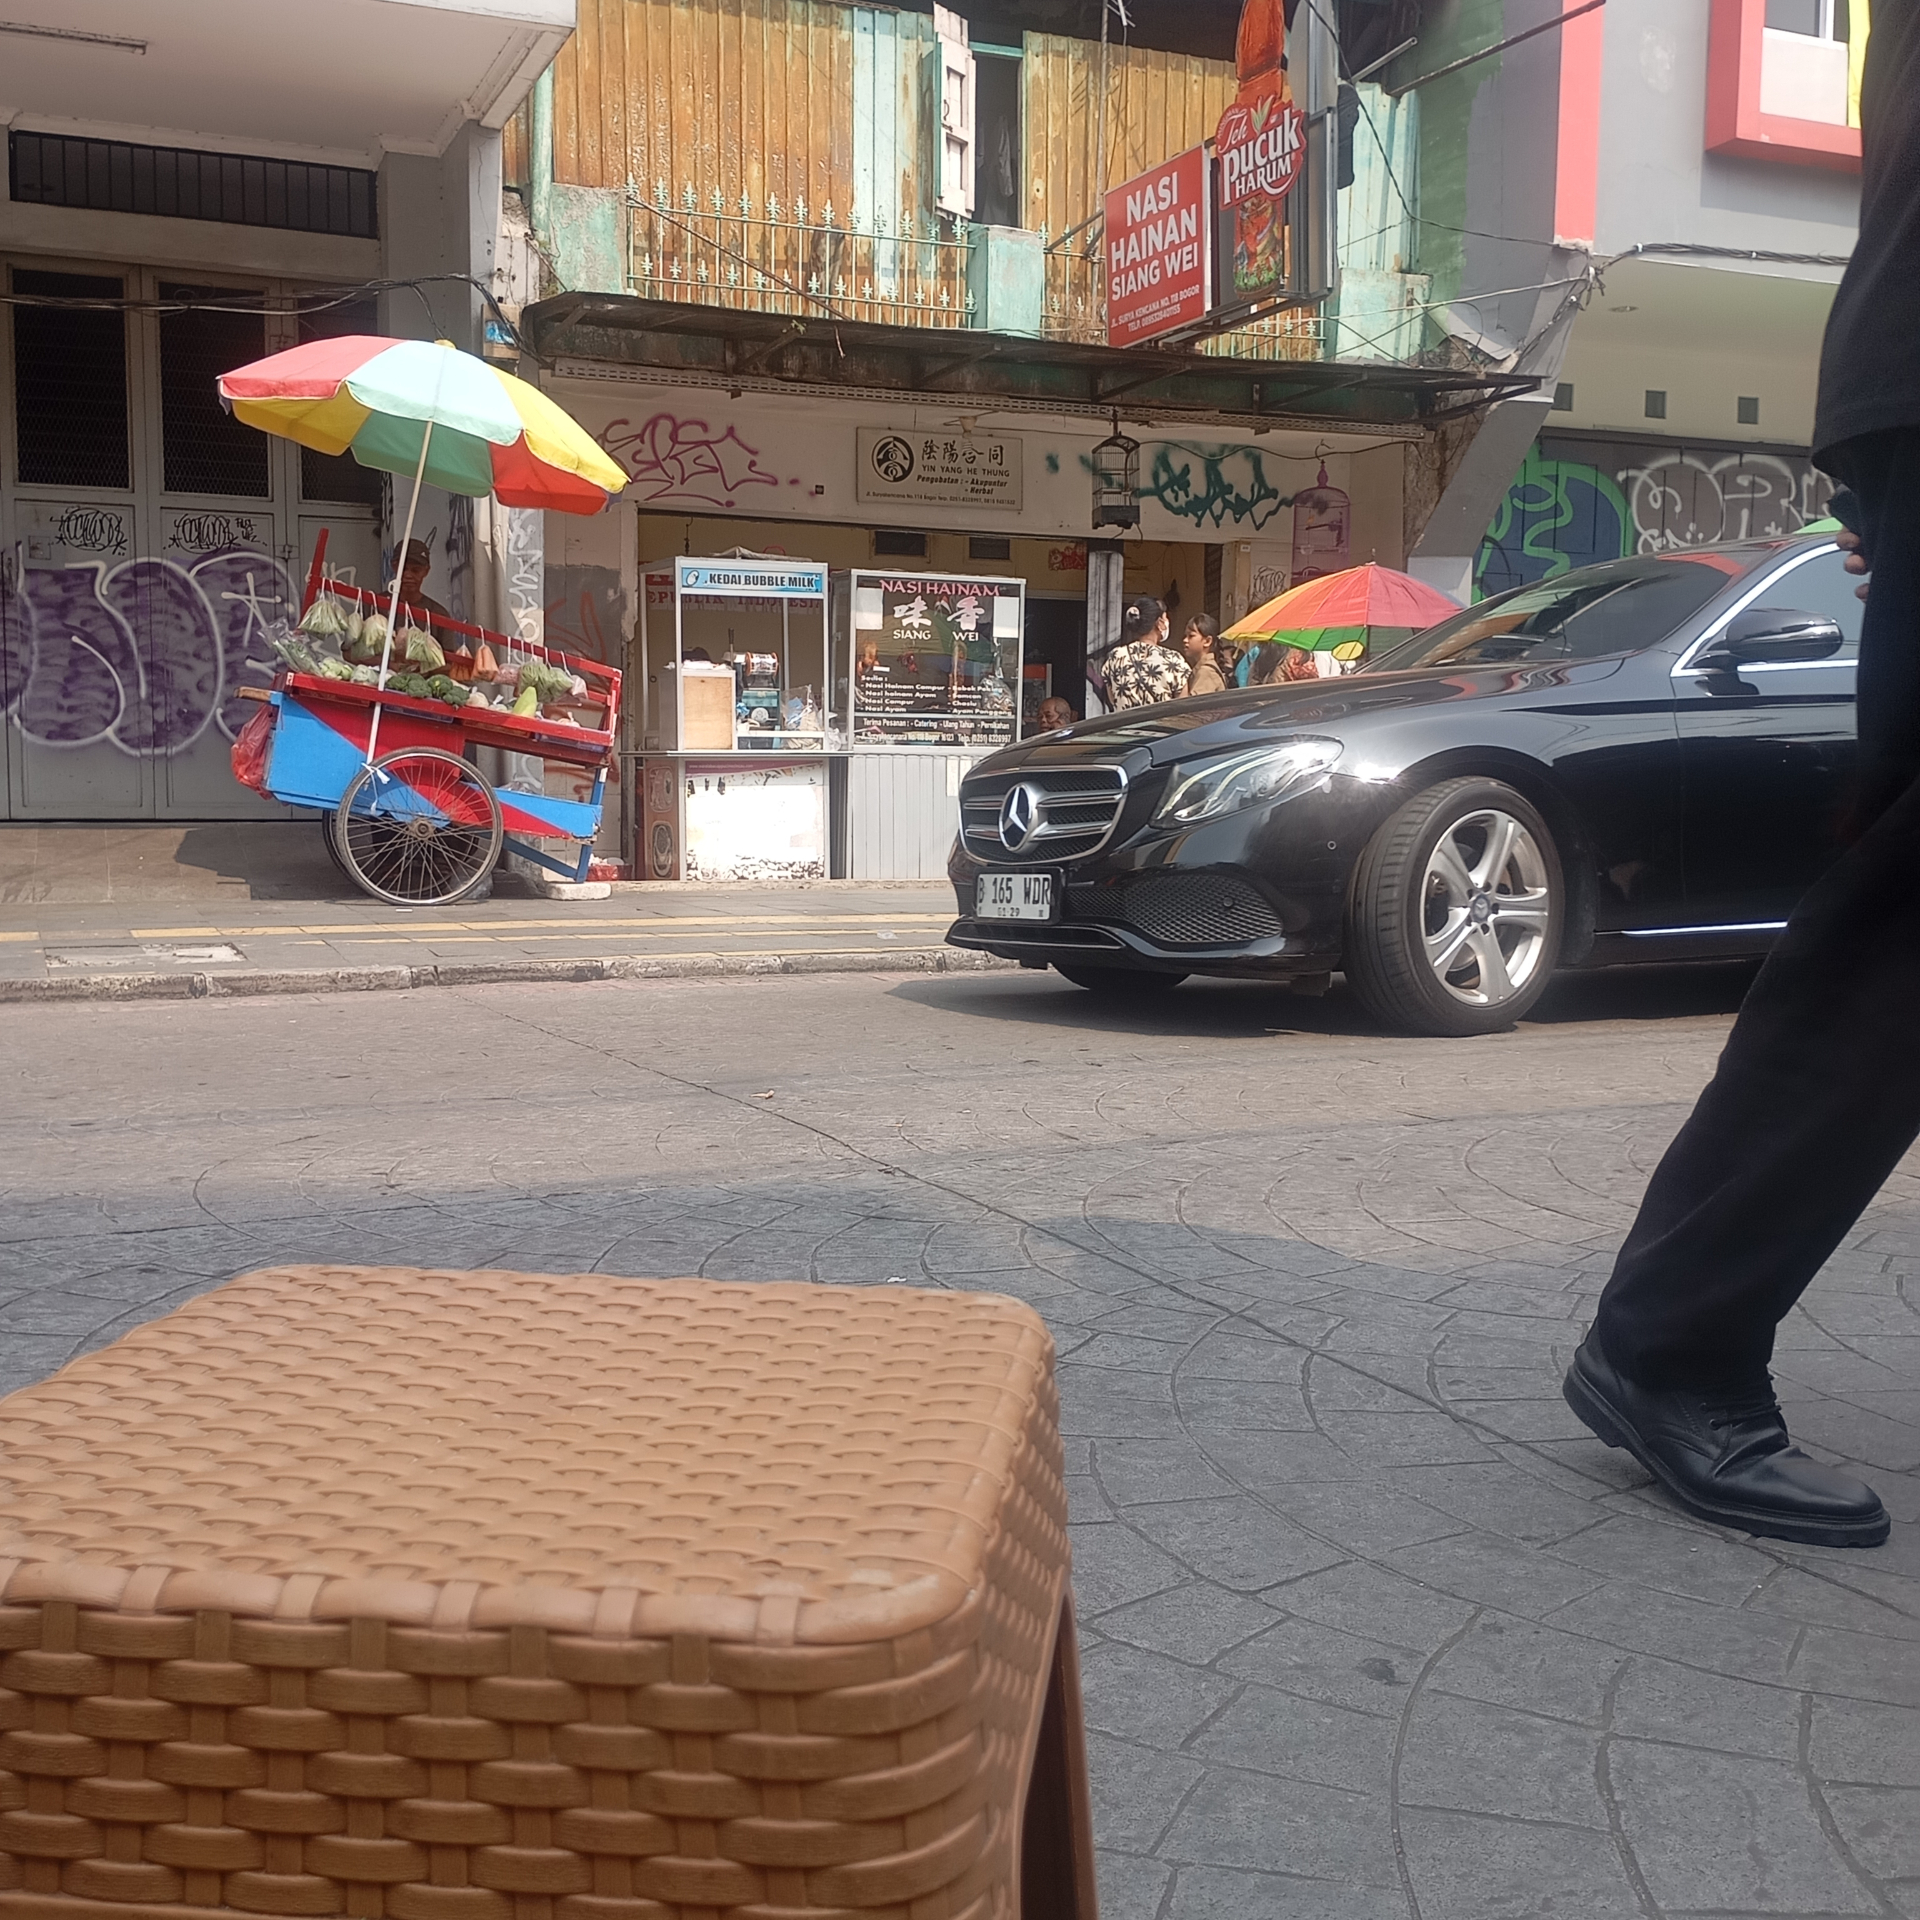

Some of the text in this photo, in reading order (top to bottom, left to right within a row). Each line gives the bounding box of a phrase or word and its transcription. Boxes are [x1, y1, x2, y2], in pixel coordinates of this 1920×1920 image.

[1218, 108, 1248, 153] Teh
[1235, 154, 1293, 199] HARUM
[1126, 171, 1178, 227] NASI
[1111, 203, 1197, 273] HAINAN
[1112, 242, 1198, 301] SIANG WEI
[1179, 284, 1200, 300] BOGOR
[922, 464, 1010, 477] YIN YANG HE THUNG
[970, 478, 1008, 488] Akupuntur
[970, 486, 994, 495] Herbal
[709, 573, 814, 588] KEDAI BUBBLE MILK
[879, 579, 1000, 596] NASI HAINAM
[893, 629, 979, 641] SIANG WEI
[975, 708, 1012, 716] Panggang
[863, 717, 881, 726] Terima
[883, 718, 906, 727] Pesanan
[960, 720, 974, 728] Tahun
[978, 877, 1051, 905] B 165 WDR
